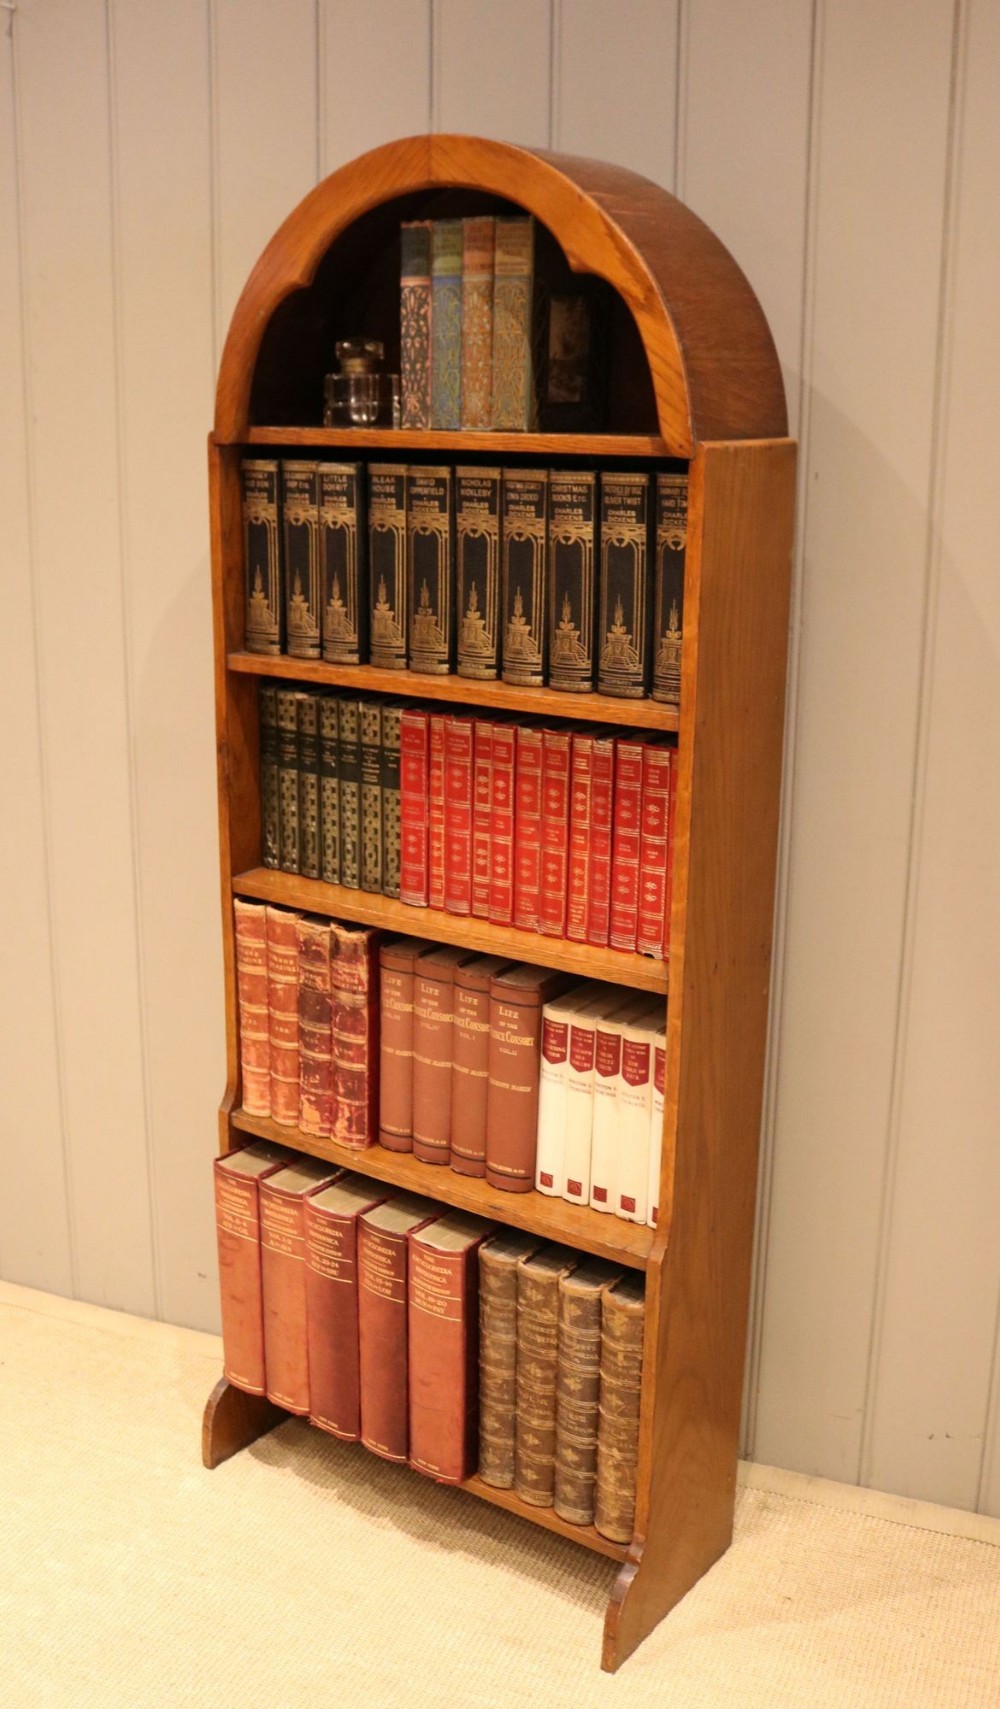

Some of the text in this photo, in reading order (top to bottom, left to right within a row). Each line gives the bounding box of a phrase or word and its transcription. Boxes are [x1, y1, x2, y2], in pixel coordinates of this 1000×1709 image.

[421, 983, 440, 996] LIFE
[459, 992, 478, 1006] LIFE
[499, 1005, 519, 1019] LIFE
